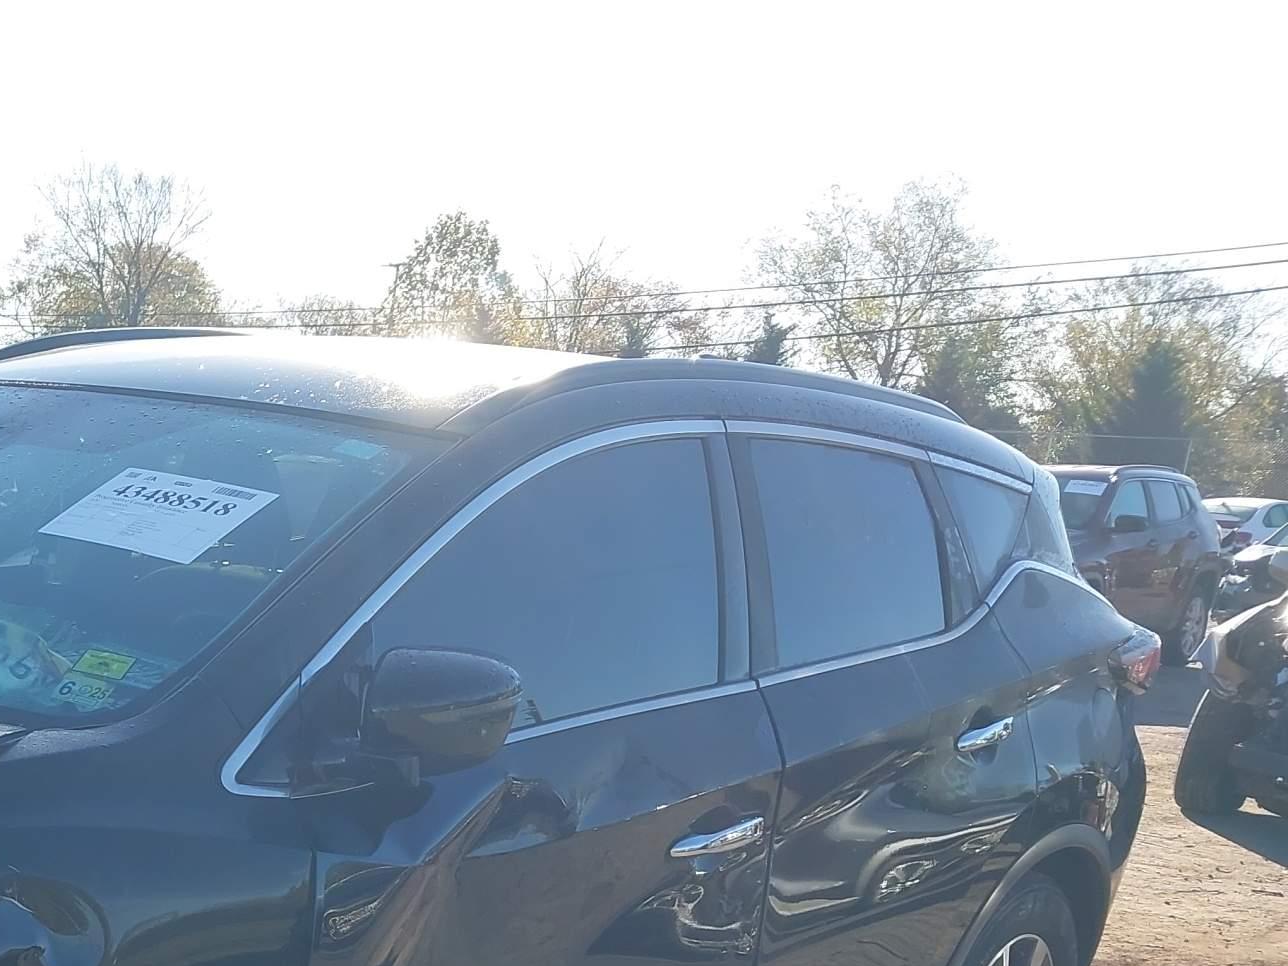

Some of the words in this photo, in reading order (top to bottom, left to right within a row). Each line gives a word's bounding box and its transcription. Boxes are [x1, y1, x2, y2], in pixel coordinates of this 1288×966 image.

[112, 484, 238, 516] 43488518
[59, 681, 76, 696] 6
[89, 687, 109, 700] 25
